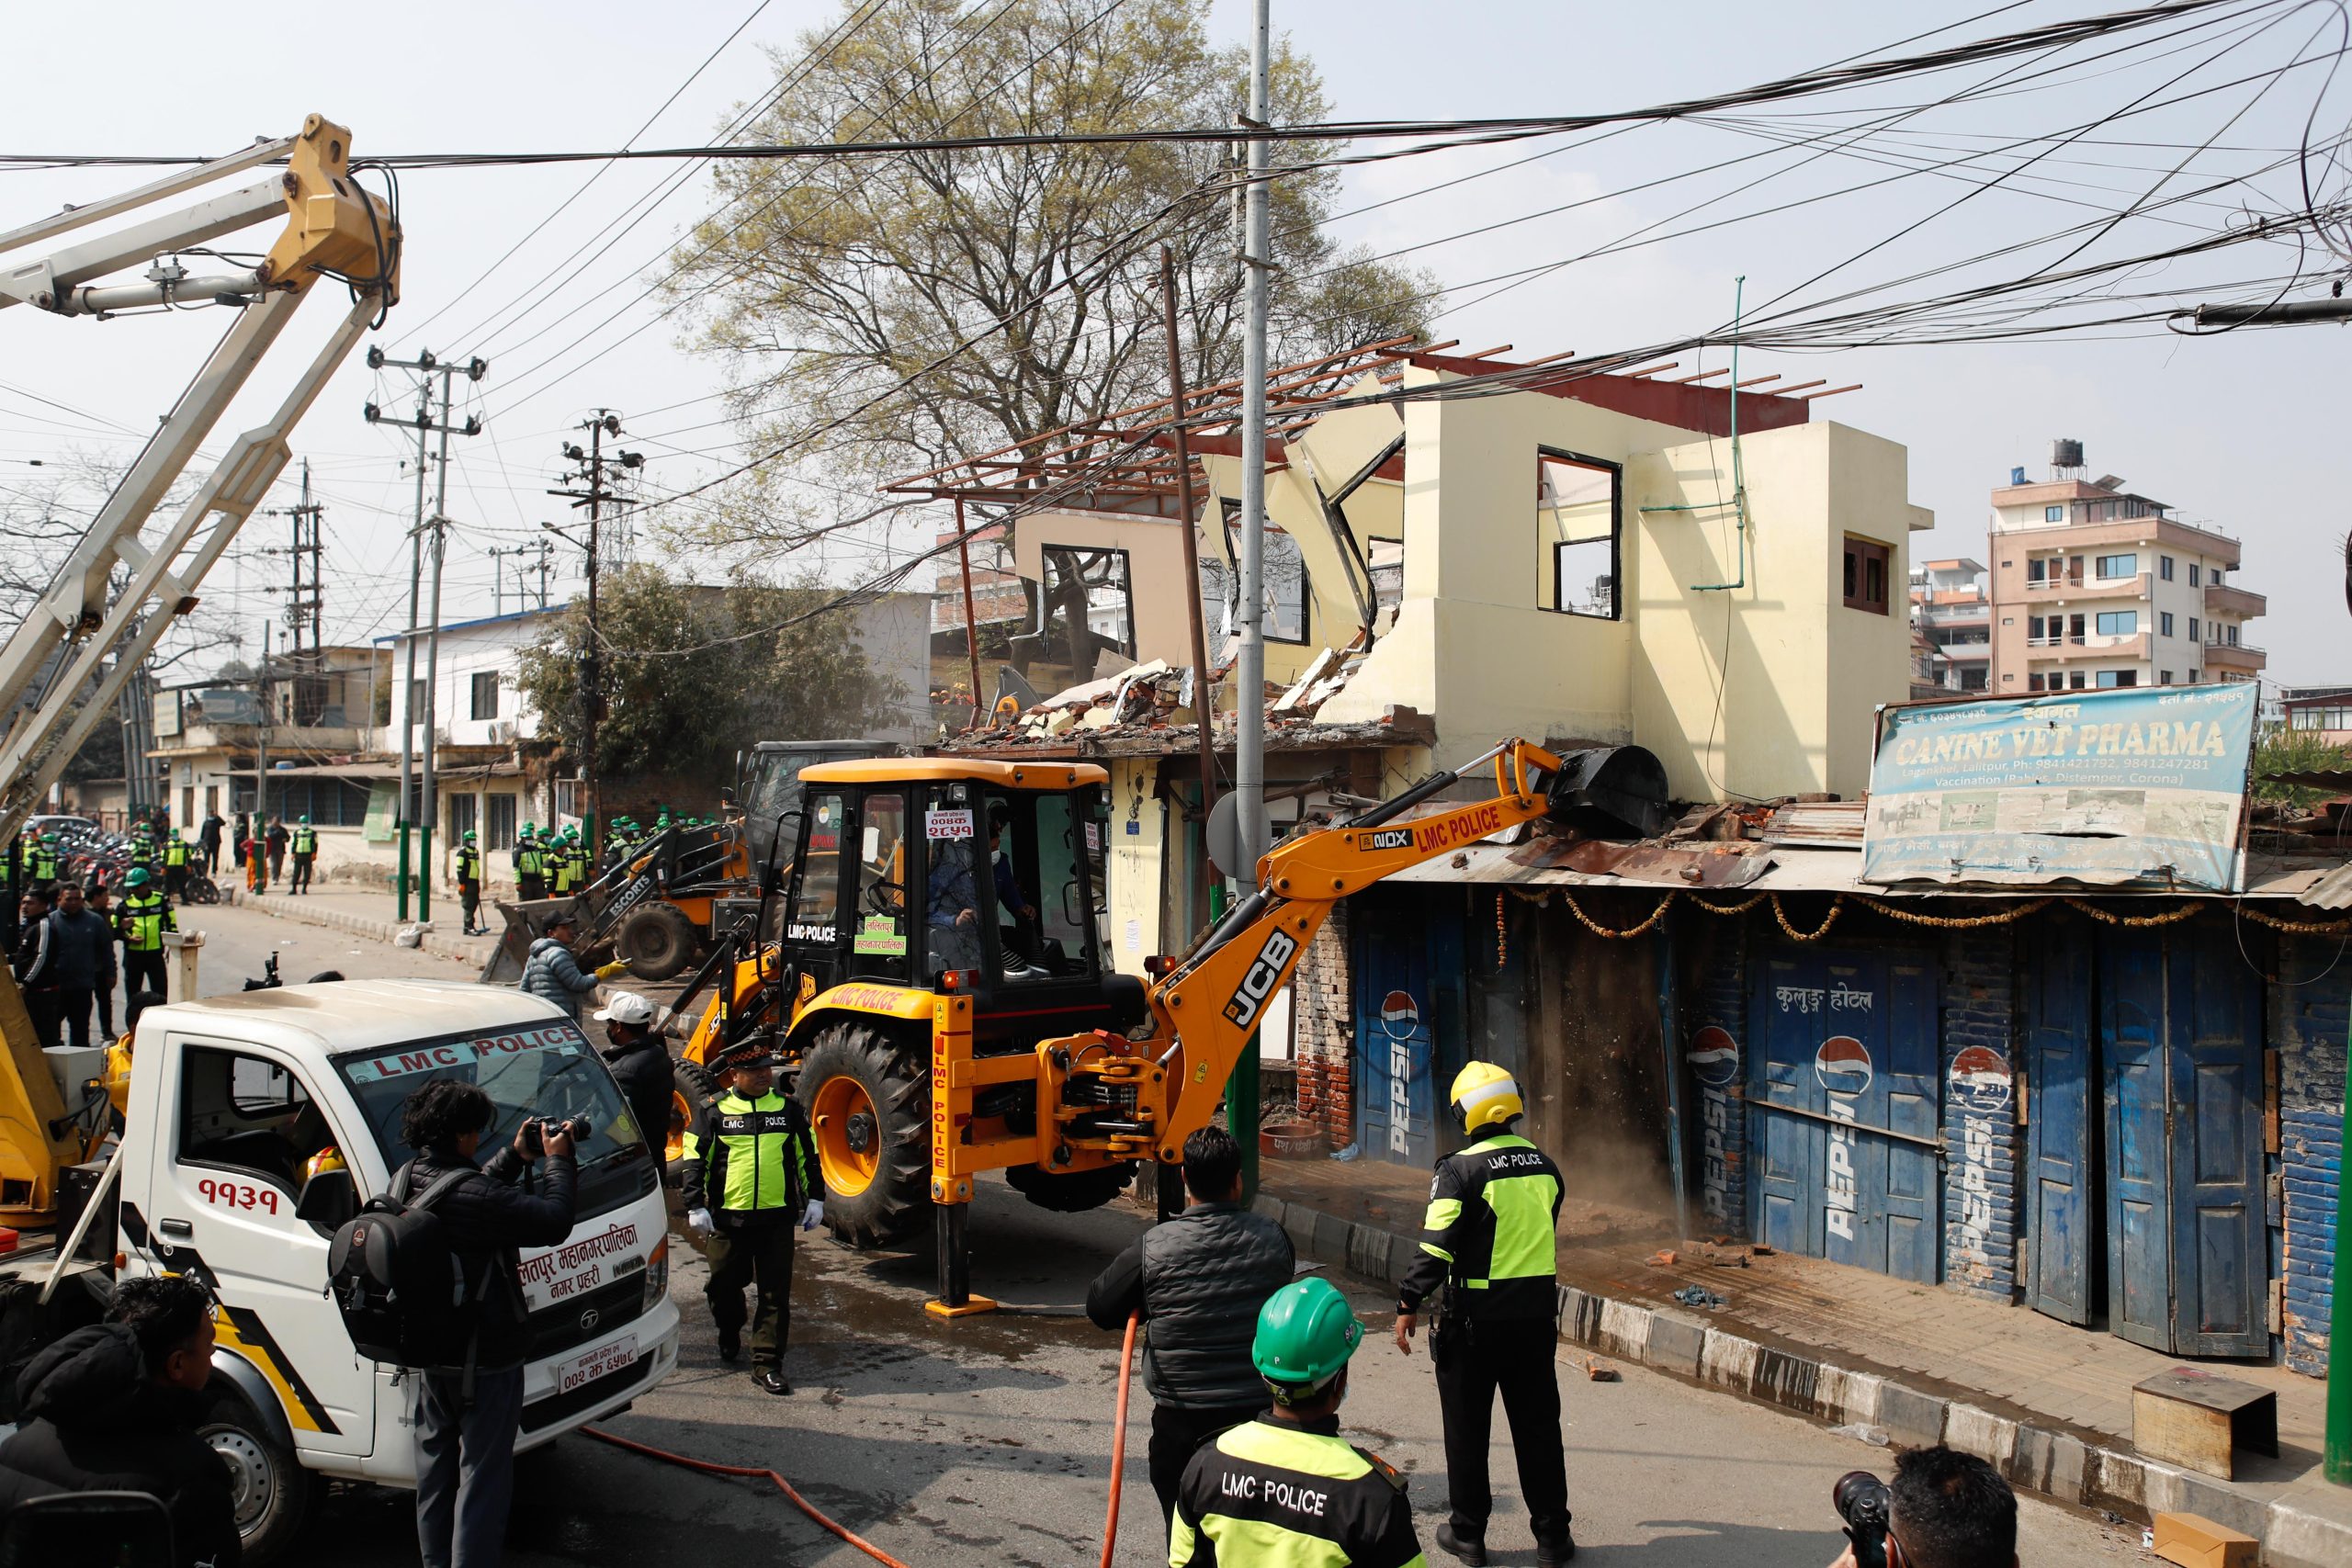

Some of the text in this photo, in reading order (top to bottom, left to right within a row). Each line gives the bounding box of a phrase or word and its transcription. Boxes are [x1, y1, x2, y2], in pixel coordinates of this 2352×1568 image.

[2021, 704, 2080, 720] स्वागत
[1896, 721, 2225, 765] CANINE VET PHARMA
[1935, 776, 2001, 787] Vaccination
[2056, 773, 2124, 784] Distemper,
[2130, 773, 2184, 785] Corona)
[1963, 761, 2008, 773] Lalitpur,
[2014, 760, 2032, 770] Ph:
[2124, 759, 2209, 770] 9841247281
[929, 826, 971, 837] २८५१
[1416, 806, 1500, 852] LMC POLICE
[609, 874, 650, 916] ESCORTS
[788, 924, 836, 942] LMC POLICE
[865, 919, 893, 933] ललितपुर
[803, 975, 816, 999] JCB
[1235, 931, 1295, 1025] JCB
[831, 987, 903, 1010] LMC POLICE
[1830, 981, 1873, 1012] होटल
[709, 1010, 720, 1033] JC
[373, 1027, 580, 1077] LMC POLICE
[933, 1057, 946, 1168] LMC POLICE
[1390, 1042, 1409, 1156] PEPSI
[765, 1116, 786, 1126] POLICE
[1487, 1153, 1544, 1169] LMC POLICE
[1702, 1087, 1728, 1220] PEPSI
[1827, 1100, 1856, 1241] PEPSI
[198, 1179, 277, 1215] ११३१
[1961, 1114, 1993, 1266] PEPSI
[557, 1224, 638, 1270] महानगरपालिका
[549, 1277, 575, 1300] नगर
[578, 1264, 600, 1292] प्रहरी
[606, 1349, 634, 1371] ६५७८
[1222, 1472, 1328, 1517] LMC POLICE
